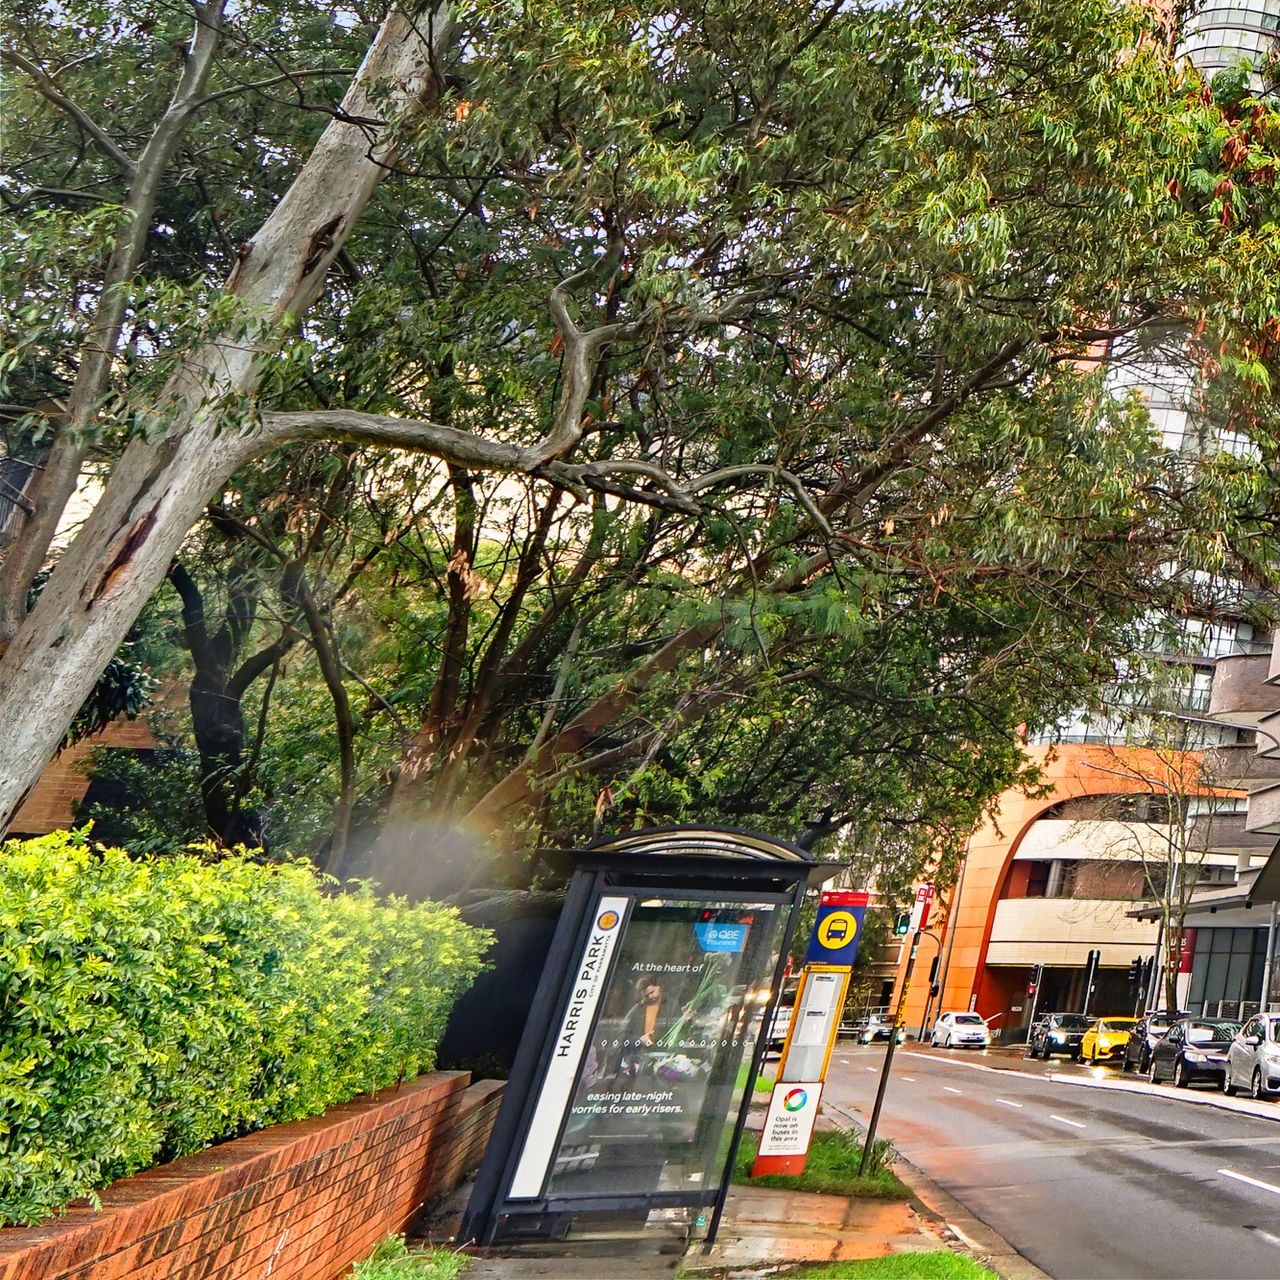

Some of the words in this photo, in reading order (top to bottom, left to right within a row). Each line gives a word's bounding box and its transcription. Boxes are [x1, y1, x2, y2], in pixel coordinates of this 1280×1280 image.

[719, 930, 740, 940] QBE
[631, 963, 644, 972] At
[646, 963, 663, 972] the
[664, 963, 690, 972] heart
[692, 963, 704, 973] of
[557, 989, 588, 1058] HARRIS
[581, 935, 605, 981] PARK
[586, 1091, 622, 1103] easing
[622, 1091, 673, 1103] late-night
[609, 1104, 625, 1113] for
[625, 1103, 651, 1116] early
[651, 1104, 684, 1114] risers.
